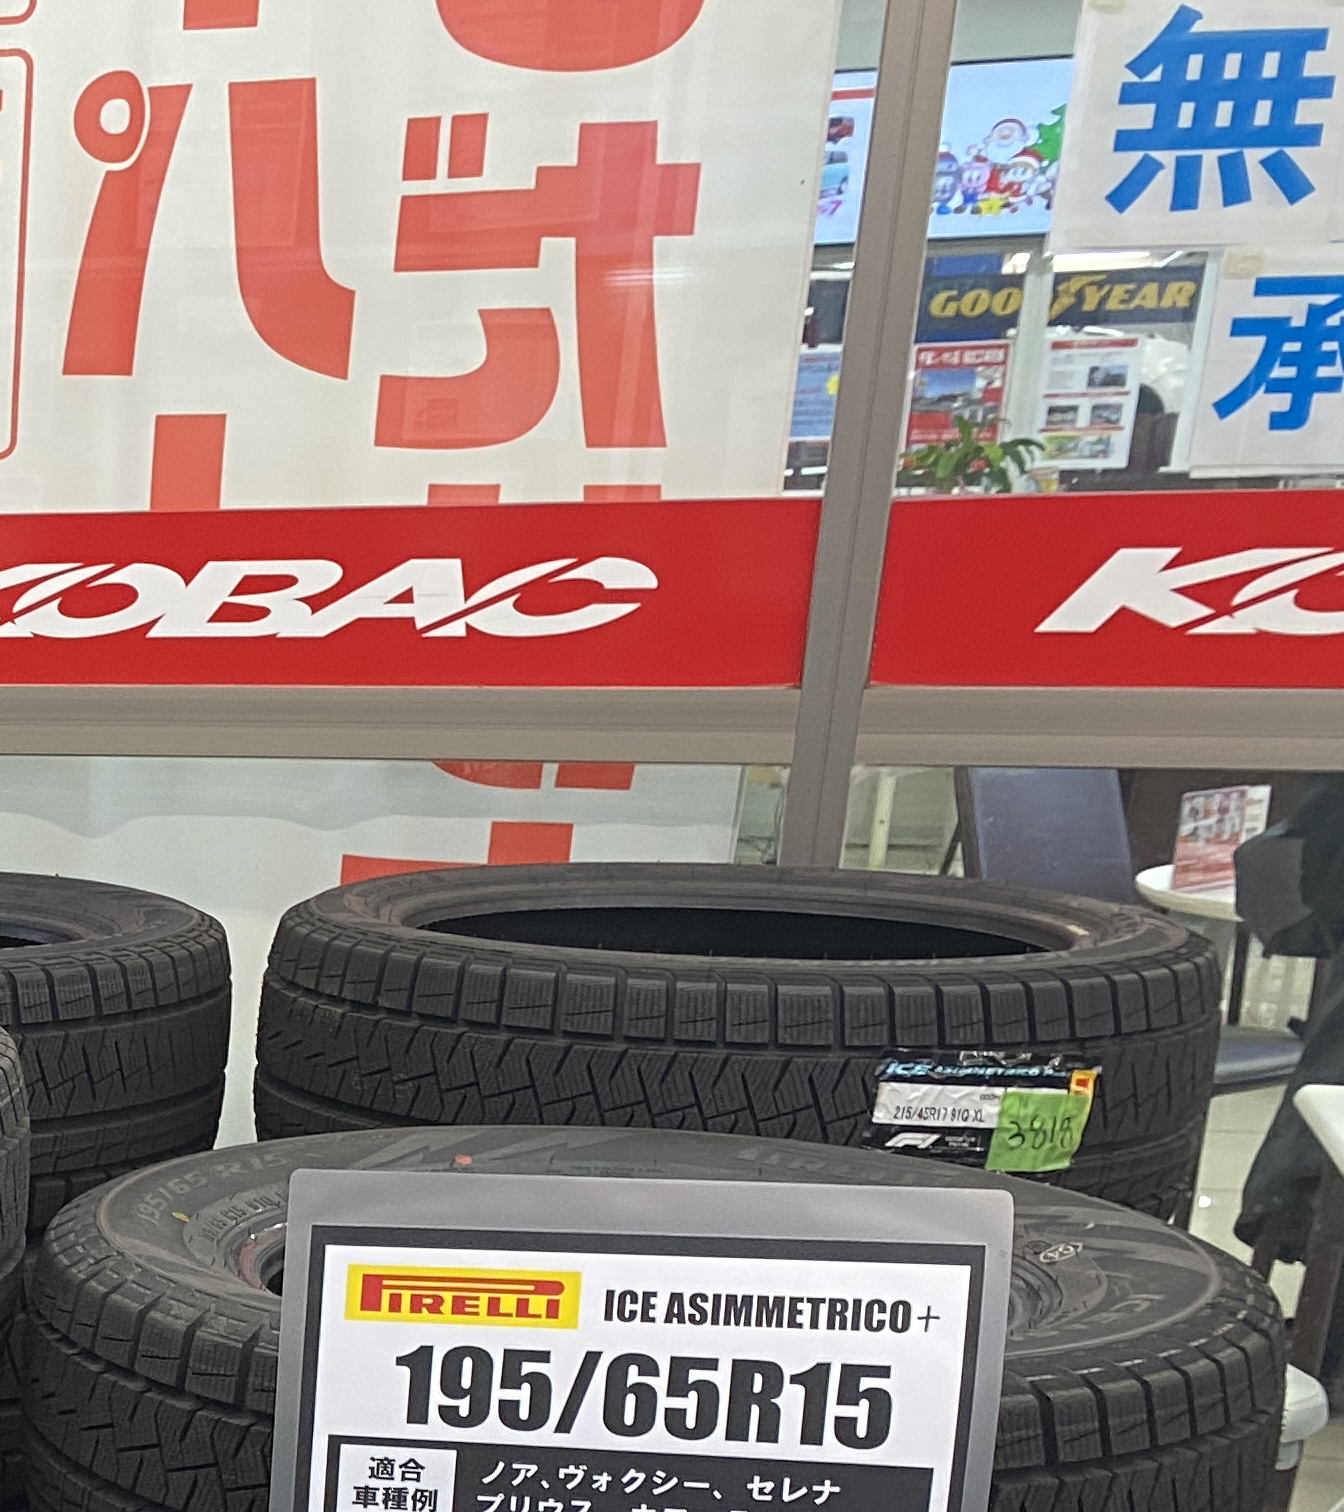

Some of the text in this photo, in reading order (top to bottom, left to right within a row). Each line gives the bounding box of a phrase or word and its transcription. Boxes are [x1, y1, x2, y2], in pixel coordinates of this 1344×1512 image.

[1105, 4, 1335, 213] 無
[929, 273, 1198, 320] GOOYEAR
[893, 1106, 948, 1121] 215/45R17
[359, 1273, 566, 1320] PIRELLI
[603, 1288, 657, 1325] ICE
[394, 1344, 892, 1451] 195/65R15
[367, 1456, 427, 1484] 適合
